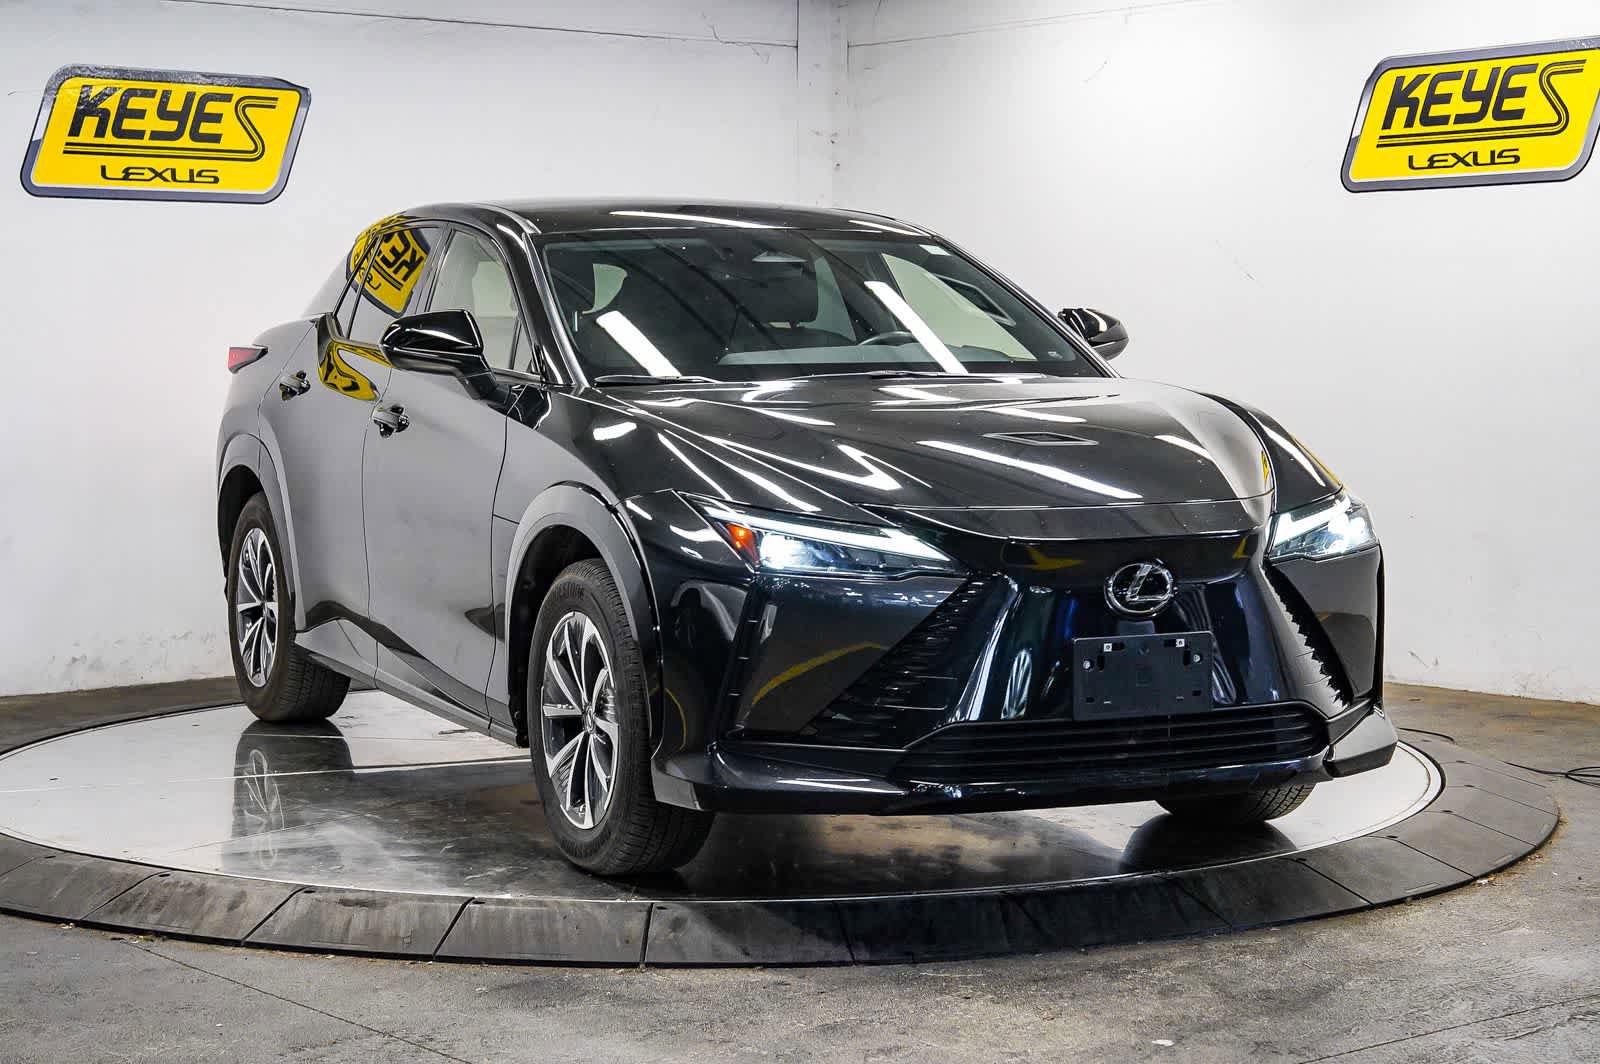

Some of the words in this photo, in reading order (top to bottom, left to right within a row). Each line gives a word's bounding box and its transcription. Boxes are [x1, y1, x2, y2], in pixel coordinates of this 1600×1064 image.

[63, 84, 278, 162] KEYES
[1376, 60, 1587, 149] KEYES
[100, 165, 220, 184] LEXUS
[1408, 149, 1521, 171] LEXUS
